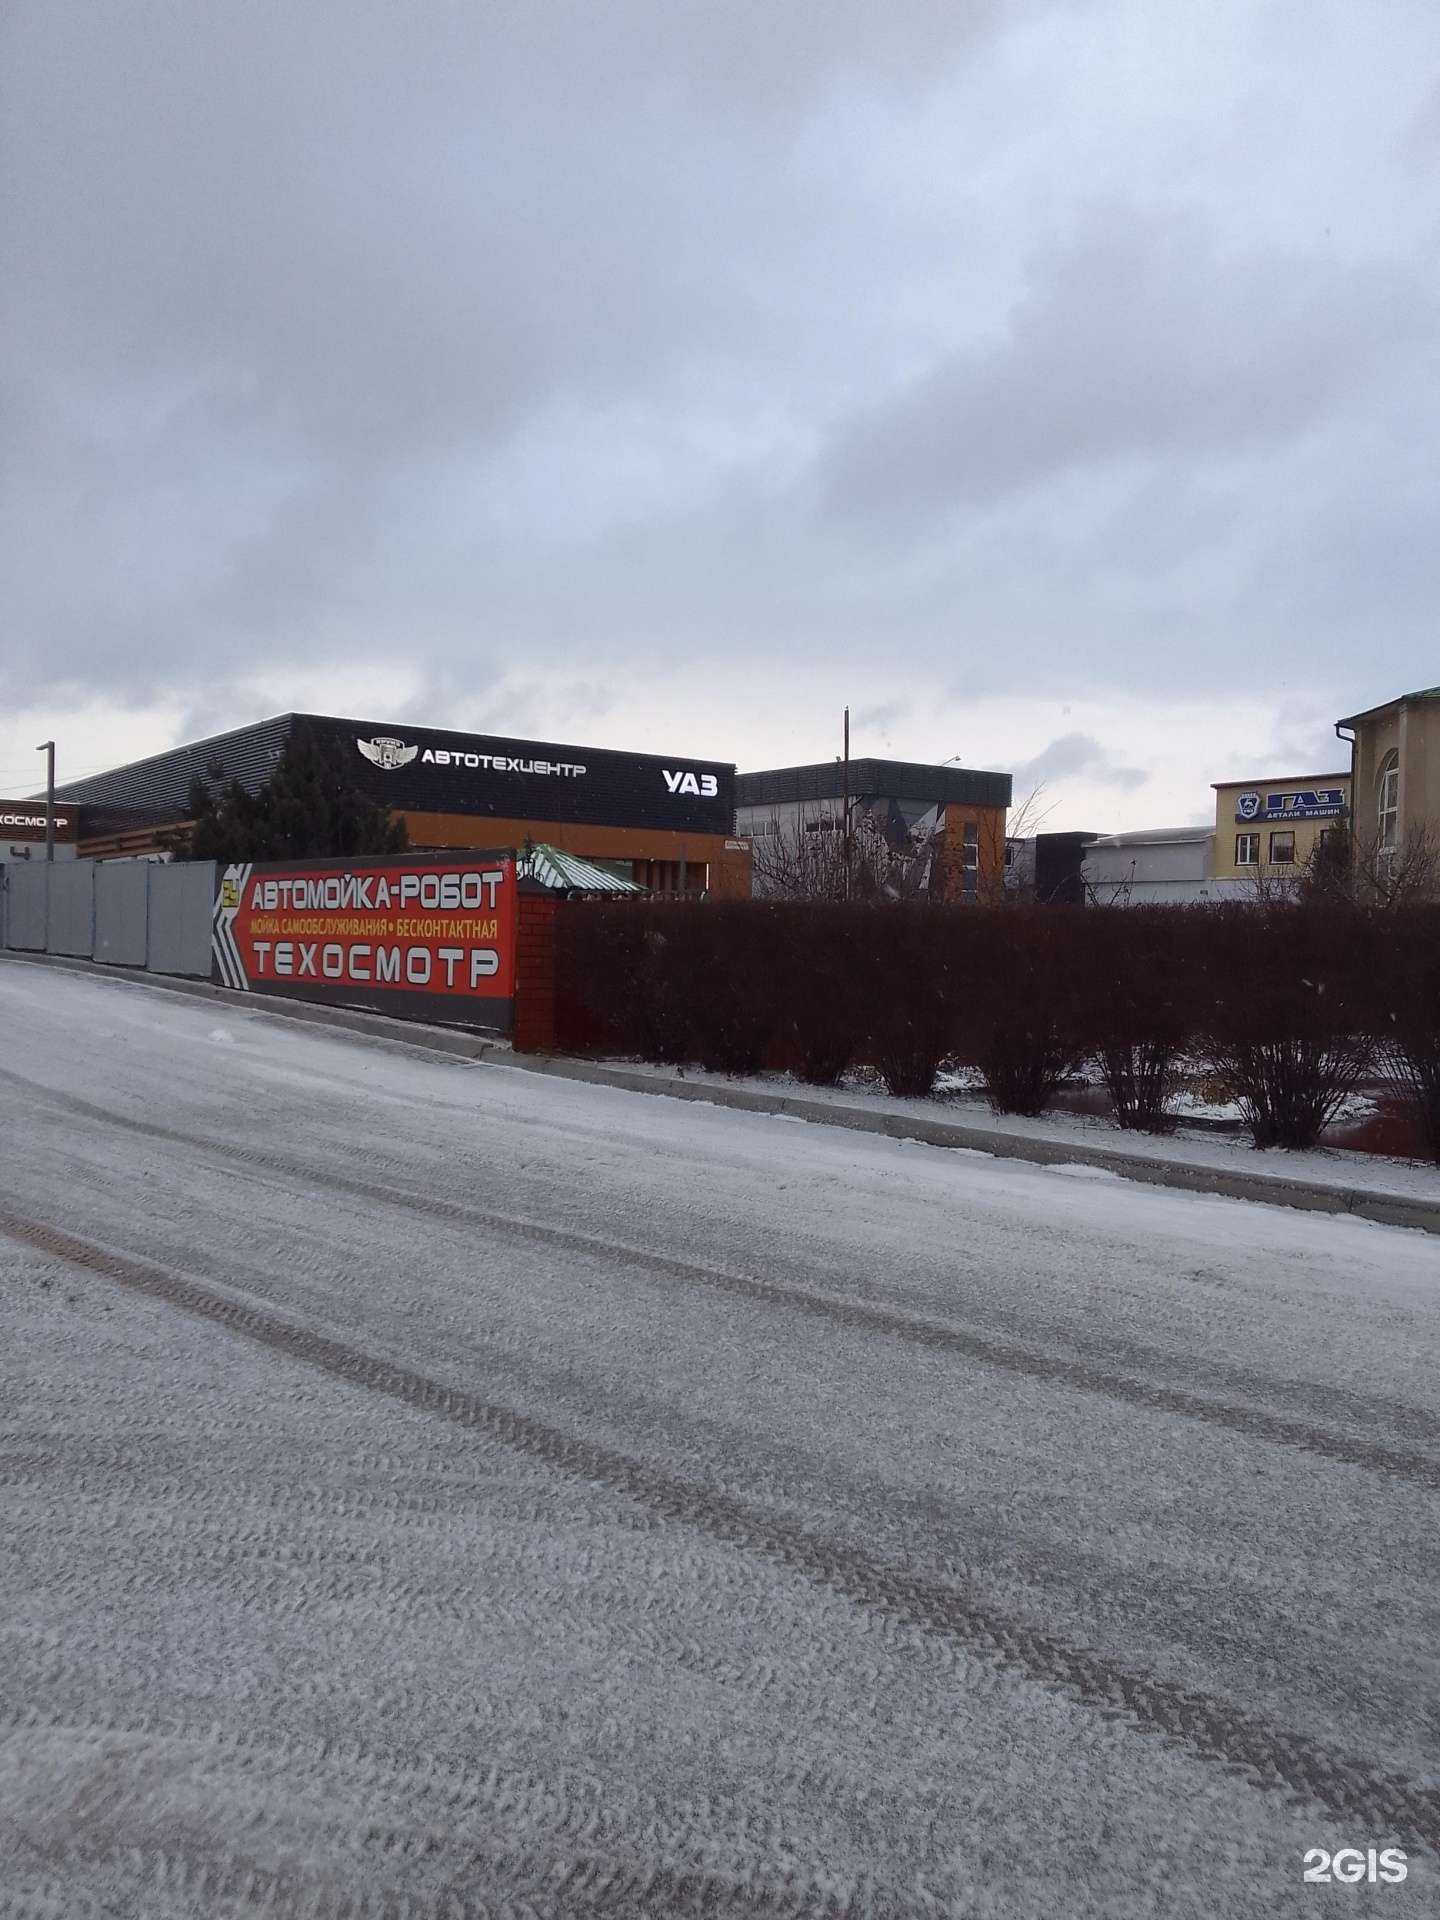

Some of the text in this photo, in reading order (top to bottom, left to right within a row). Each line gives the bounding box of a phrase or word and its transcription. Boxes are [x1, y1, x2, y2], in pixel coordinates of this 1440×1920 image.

[421, 749, 587, 777] АВТОТЕХЦЕНТР
[662, 769, 718, 797] УАЗ
[1266, 788, 1345, 810] ГАЗ
[0, 815, 68, 828] ОСМОР
[1305, 809, 1340, 817] МАШИН
[251, 871, 503, 910] АВТОМОЙКА-РОБОТ
[251, 916, 498, 939] МОЙКА САМООБСЛУЖИВАНИЯ БЕСКОНТАКТНАЯ
[253, 941, 499, 988] ТЕХОСМОТР
